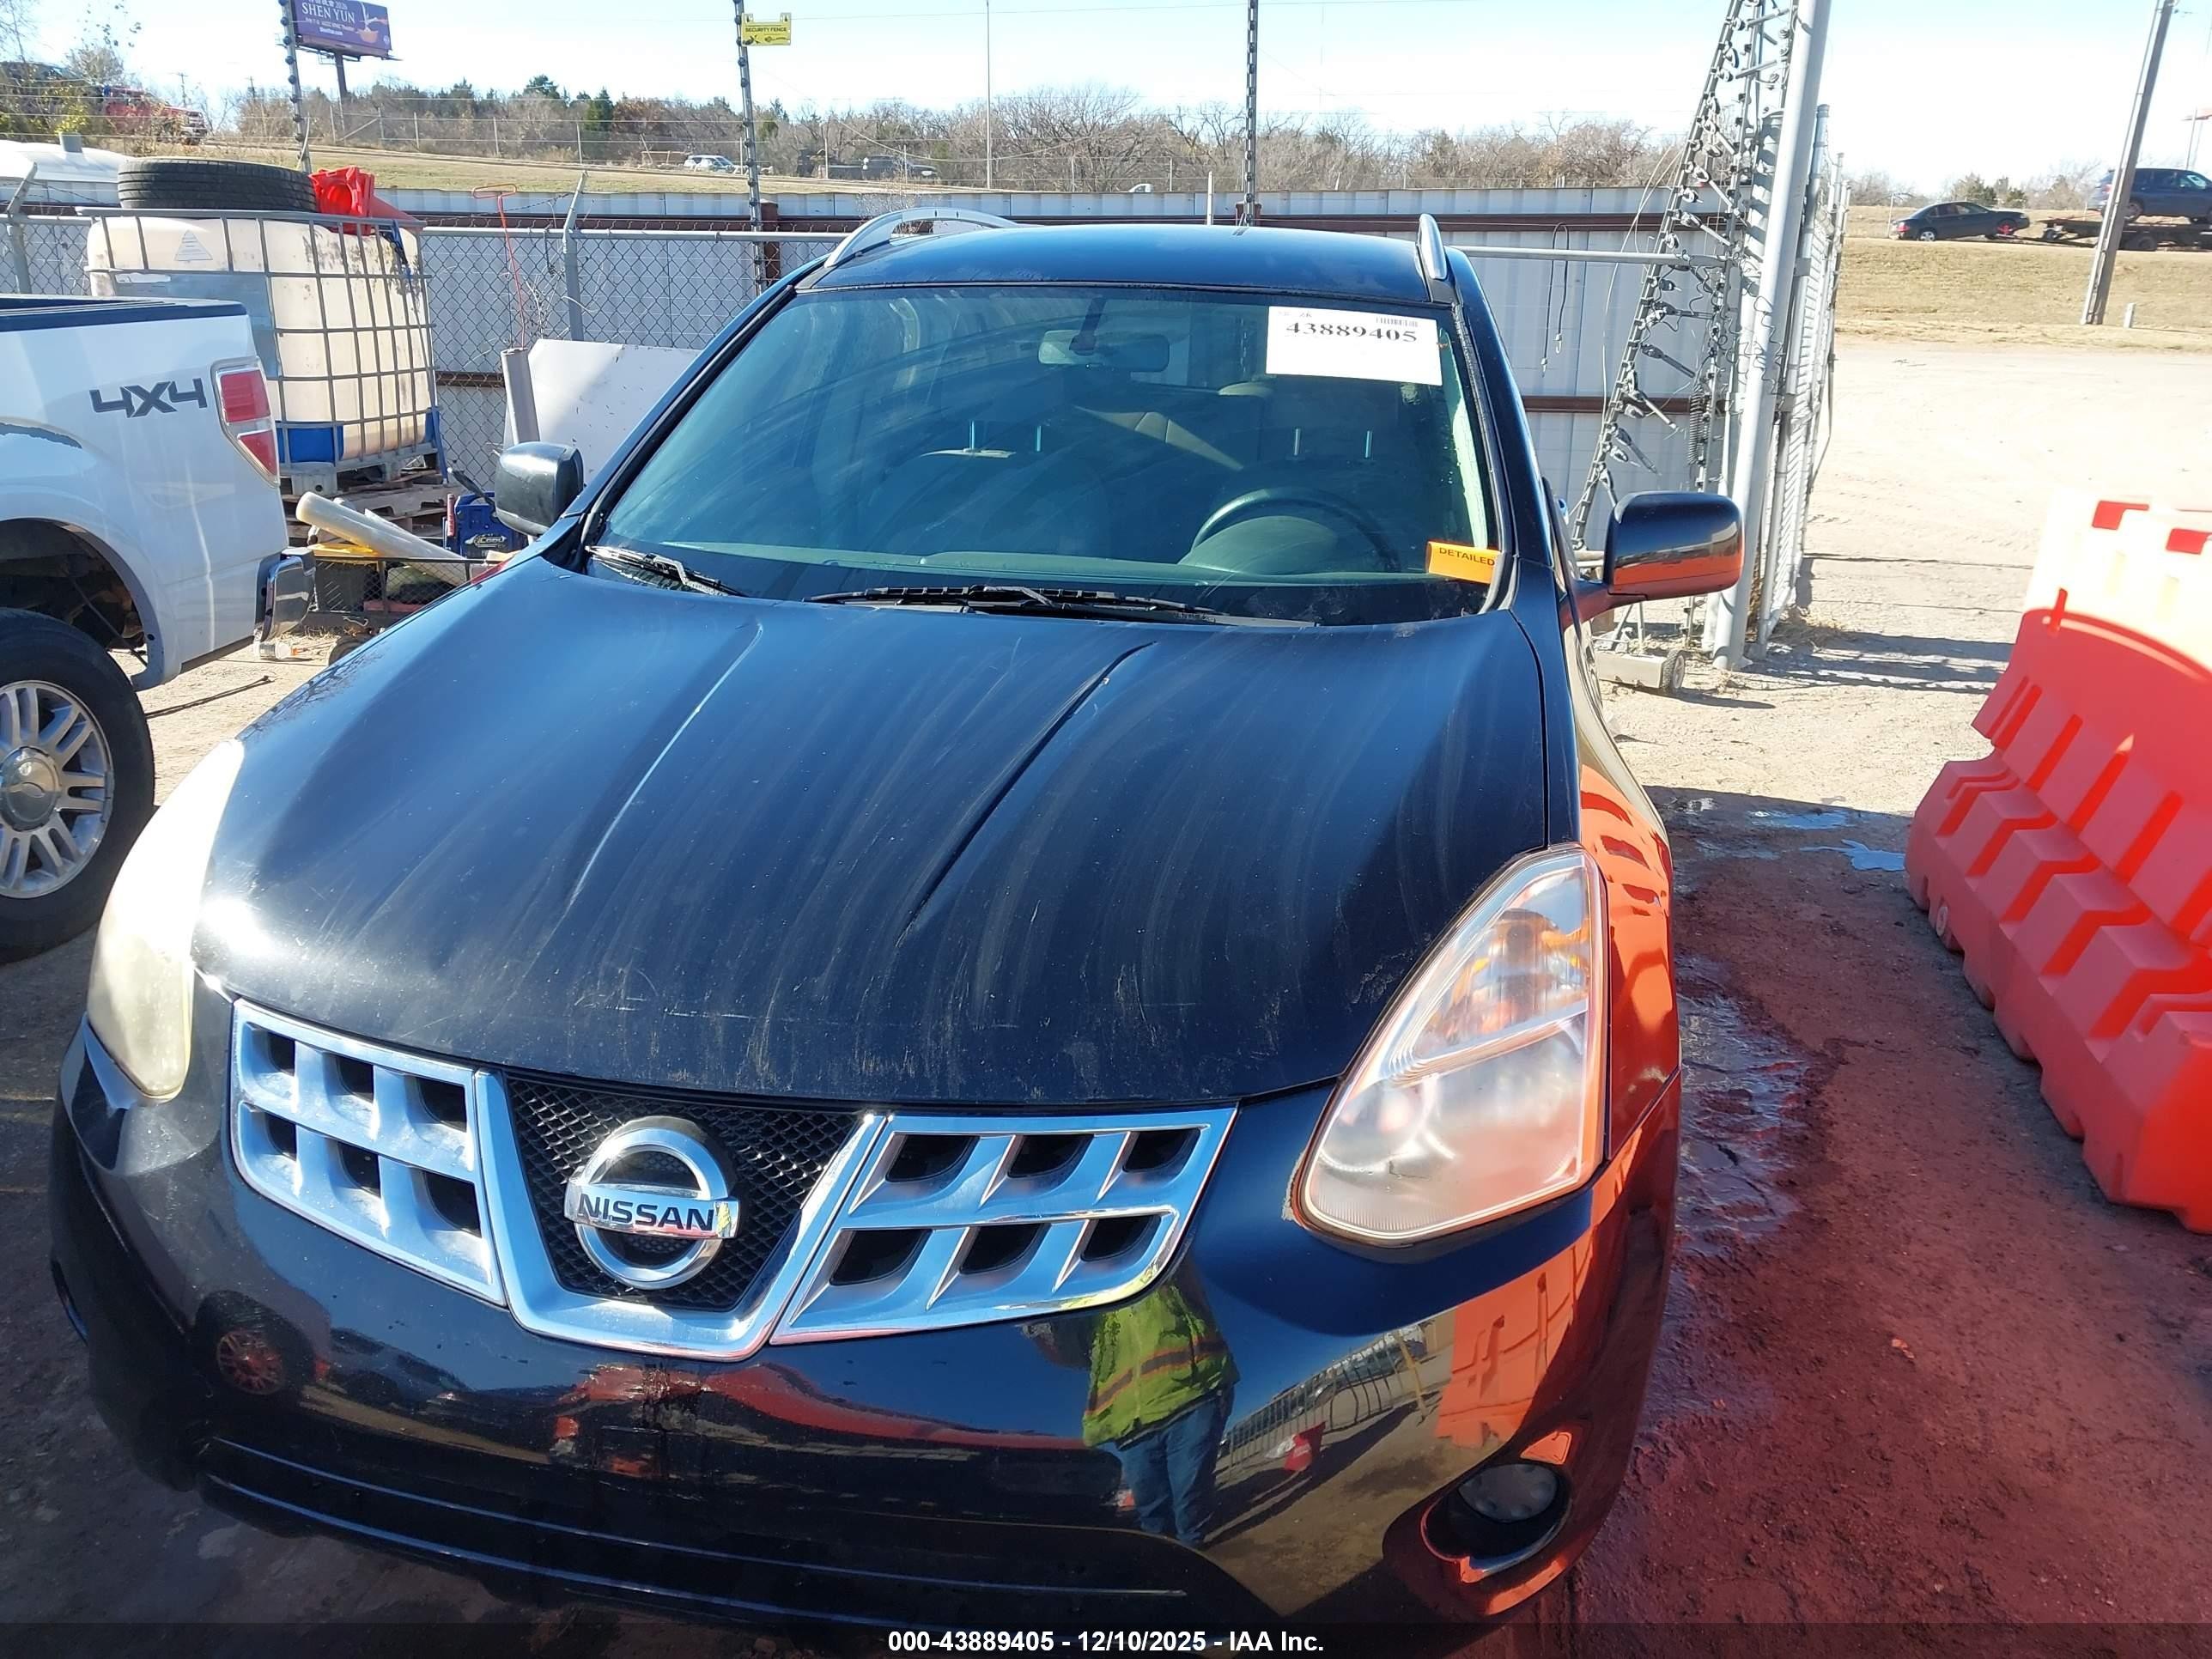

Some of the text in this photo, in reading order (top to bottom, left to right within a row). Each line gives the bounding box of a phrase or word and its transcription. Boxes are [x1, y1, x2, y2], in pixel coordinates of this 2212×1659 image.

[301, 2, 331, 19] SHEN
[333, 9, 356, 24] YUN
[1286, 322, 1418, 343] 43889405
[89, 378, 207, 418] 4X4
[1440, 548, 1495, 566] DETAILED
[577, 1194, 714, 1231] NISSAN
